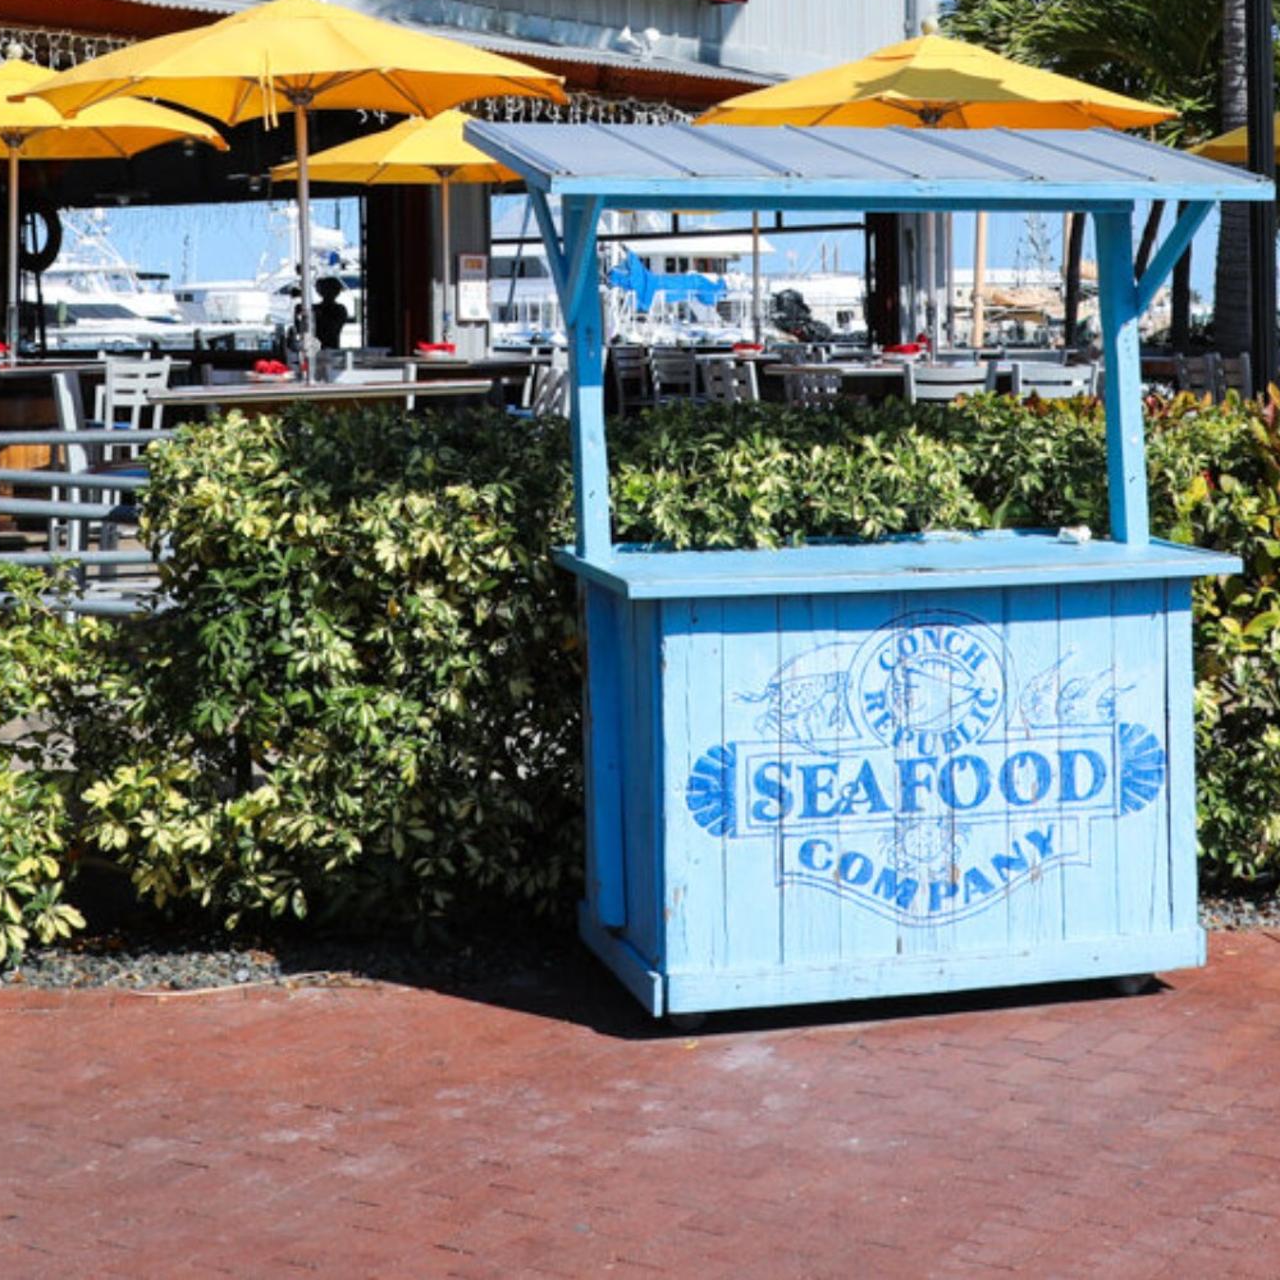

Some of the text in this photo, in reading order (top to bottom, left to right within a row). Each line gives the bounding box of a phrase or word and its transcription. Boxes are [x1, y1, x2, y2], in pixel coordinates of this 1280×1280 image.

[864, 629, 998, 756] CONCH REPUBLIC
[751, 749, 1108, 822] SEAFOOD
[798, 823, 1055, 911] COMPANY
